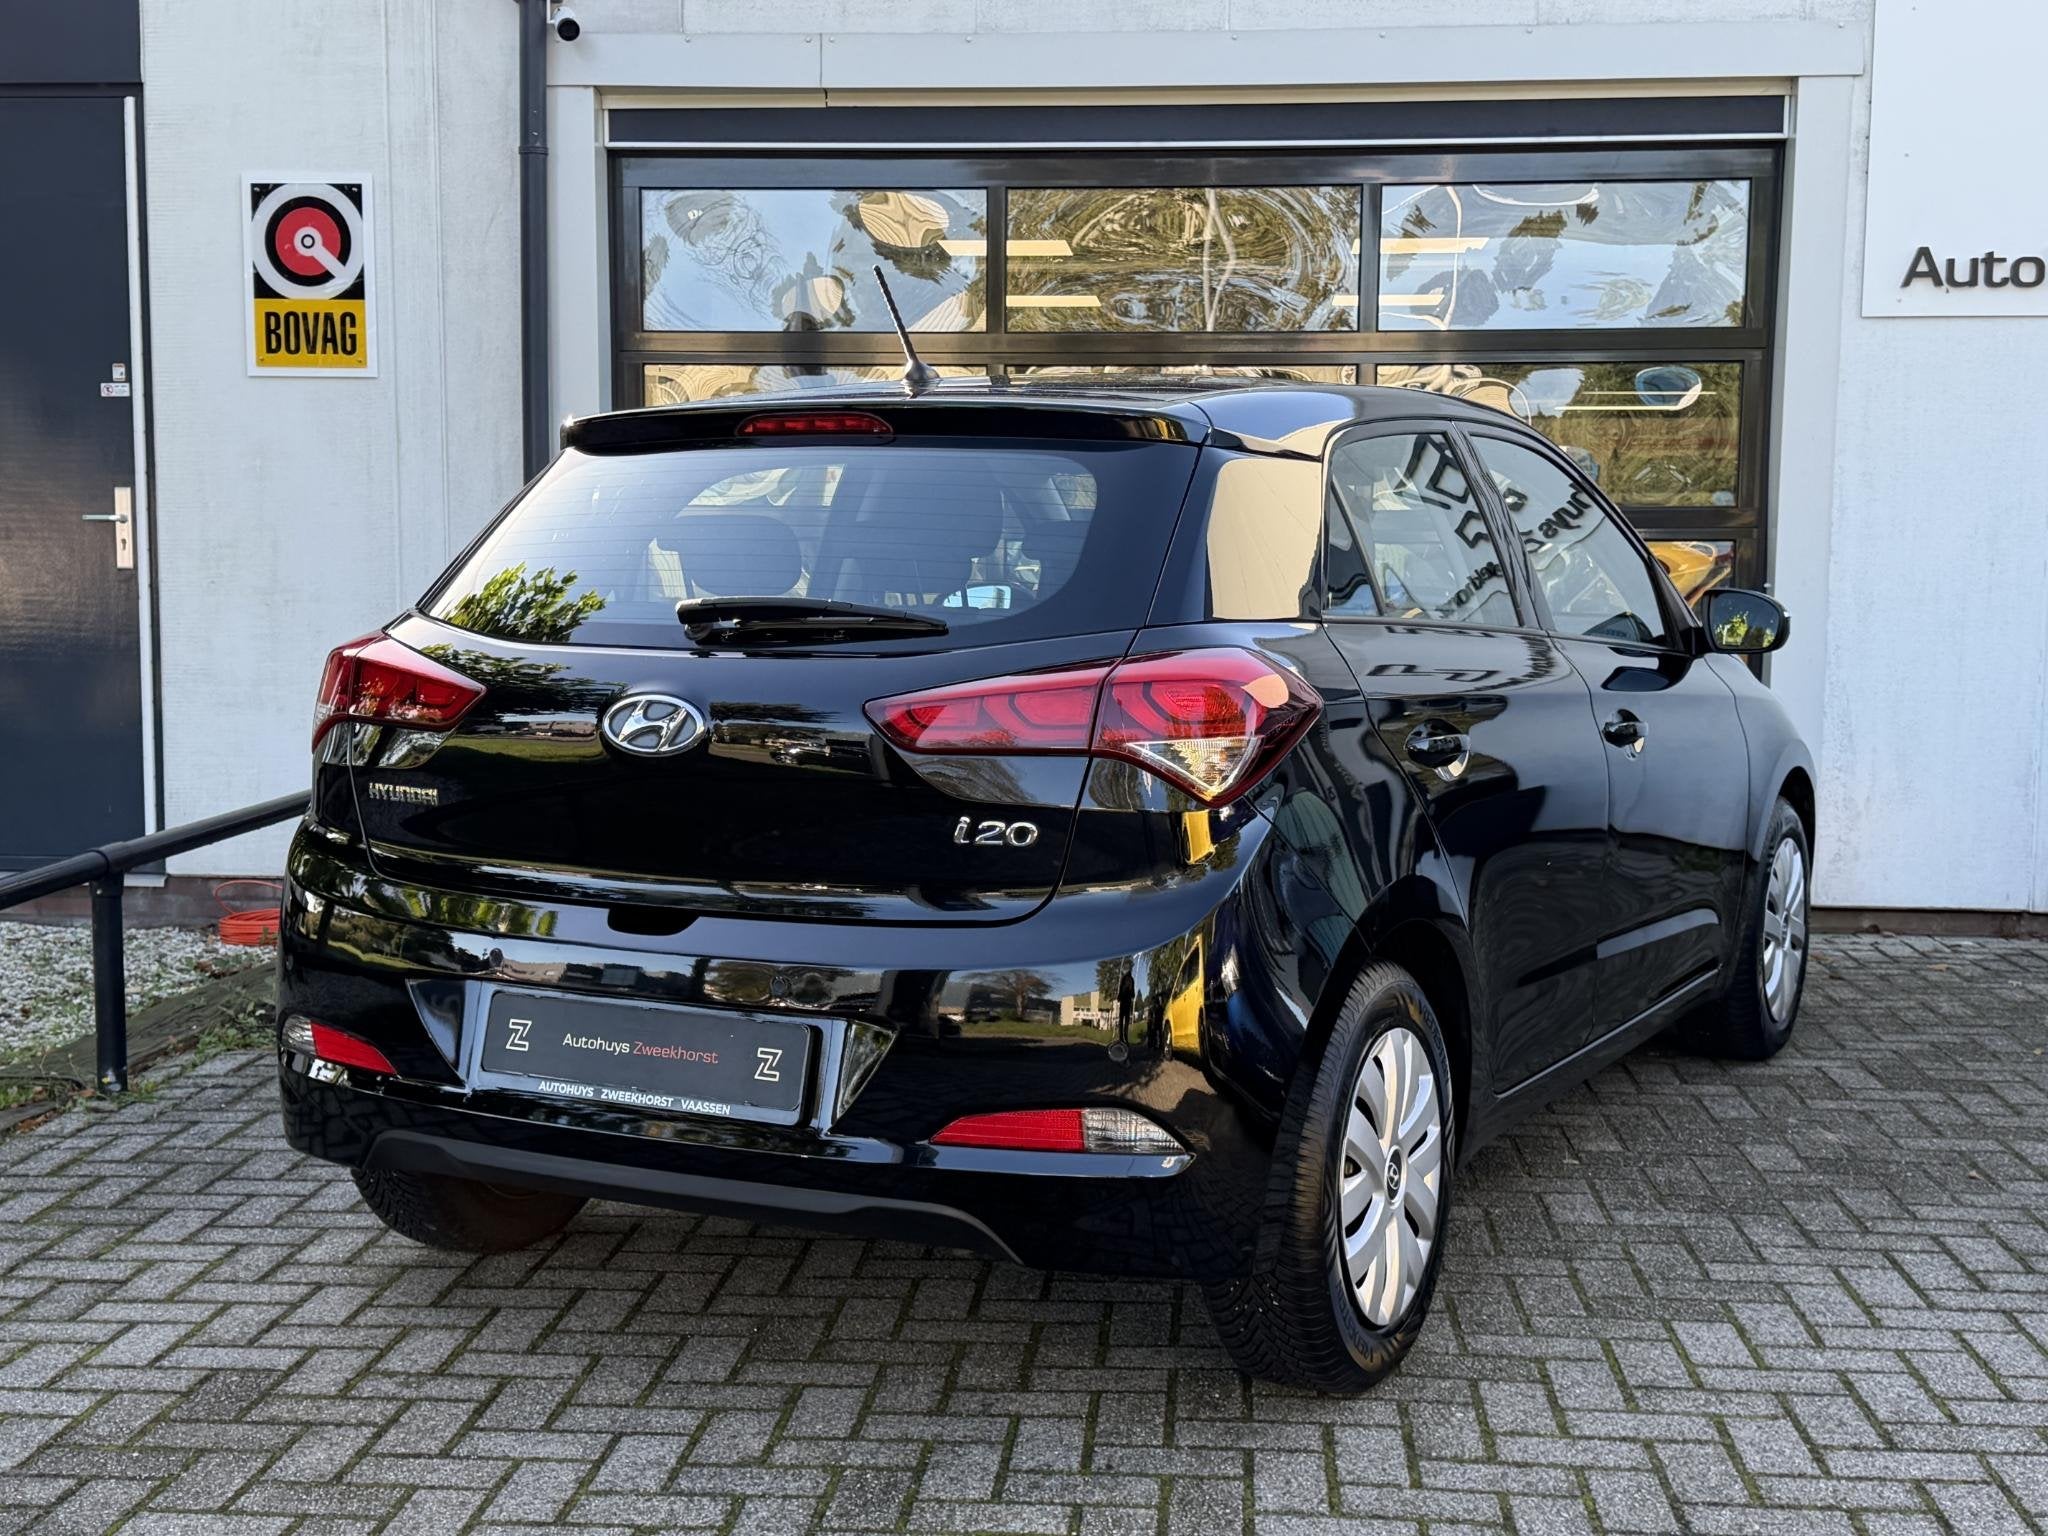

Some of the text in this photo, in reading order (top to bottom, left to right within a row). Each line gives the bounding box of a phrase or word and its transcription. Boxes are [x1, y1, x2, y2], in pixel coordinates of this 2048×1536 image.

[1901, 246, 2046, 288] Auto
[264, 311, 358, 356] BOVAG
[368, 782, 439, 806] HYUNDAI
[953, 816, 1038, 847] i20
[562, 1033, 719, 1064] Autohuys Zweekhorst
[538, 1080, 731, 1116] AUTOHUYS ZWEEKHORST VAASSEN
